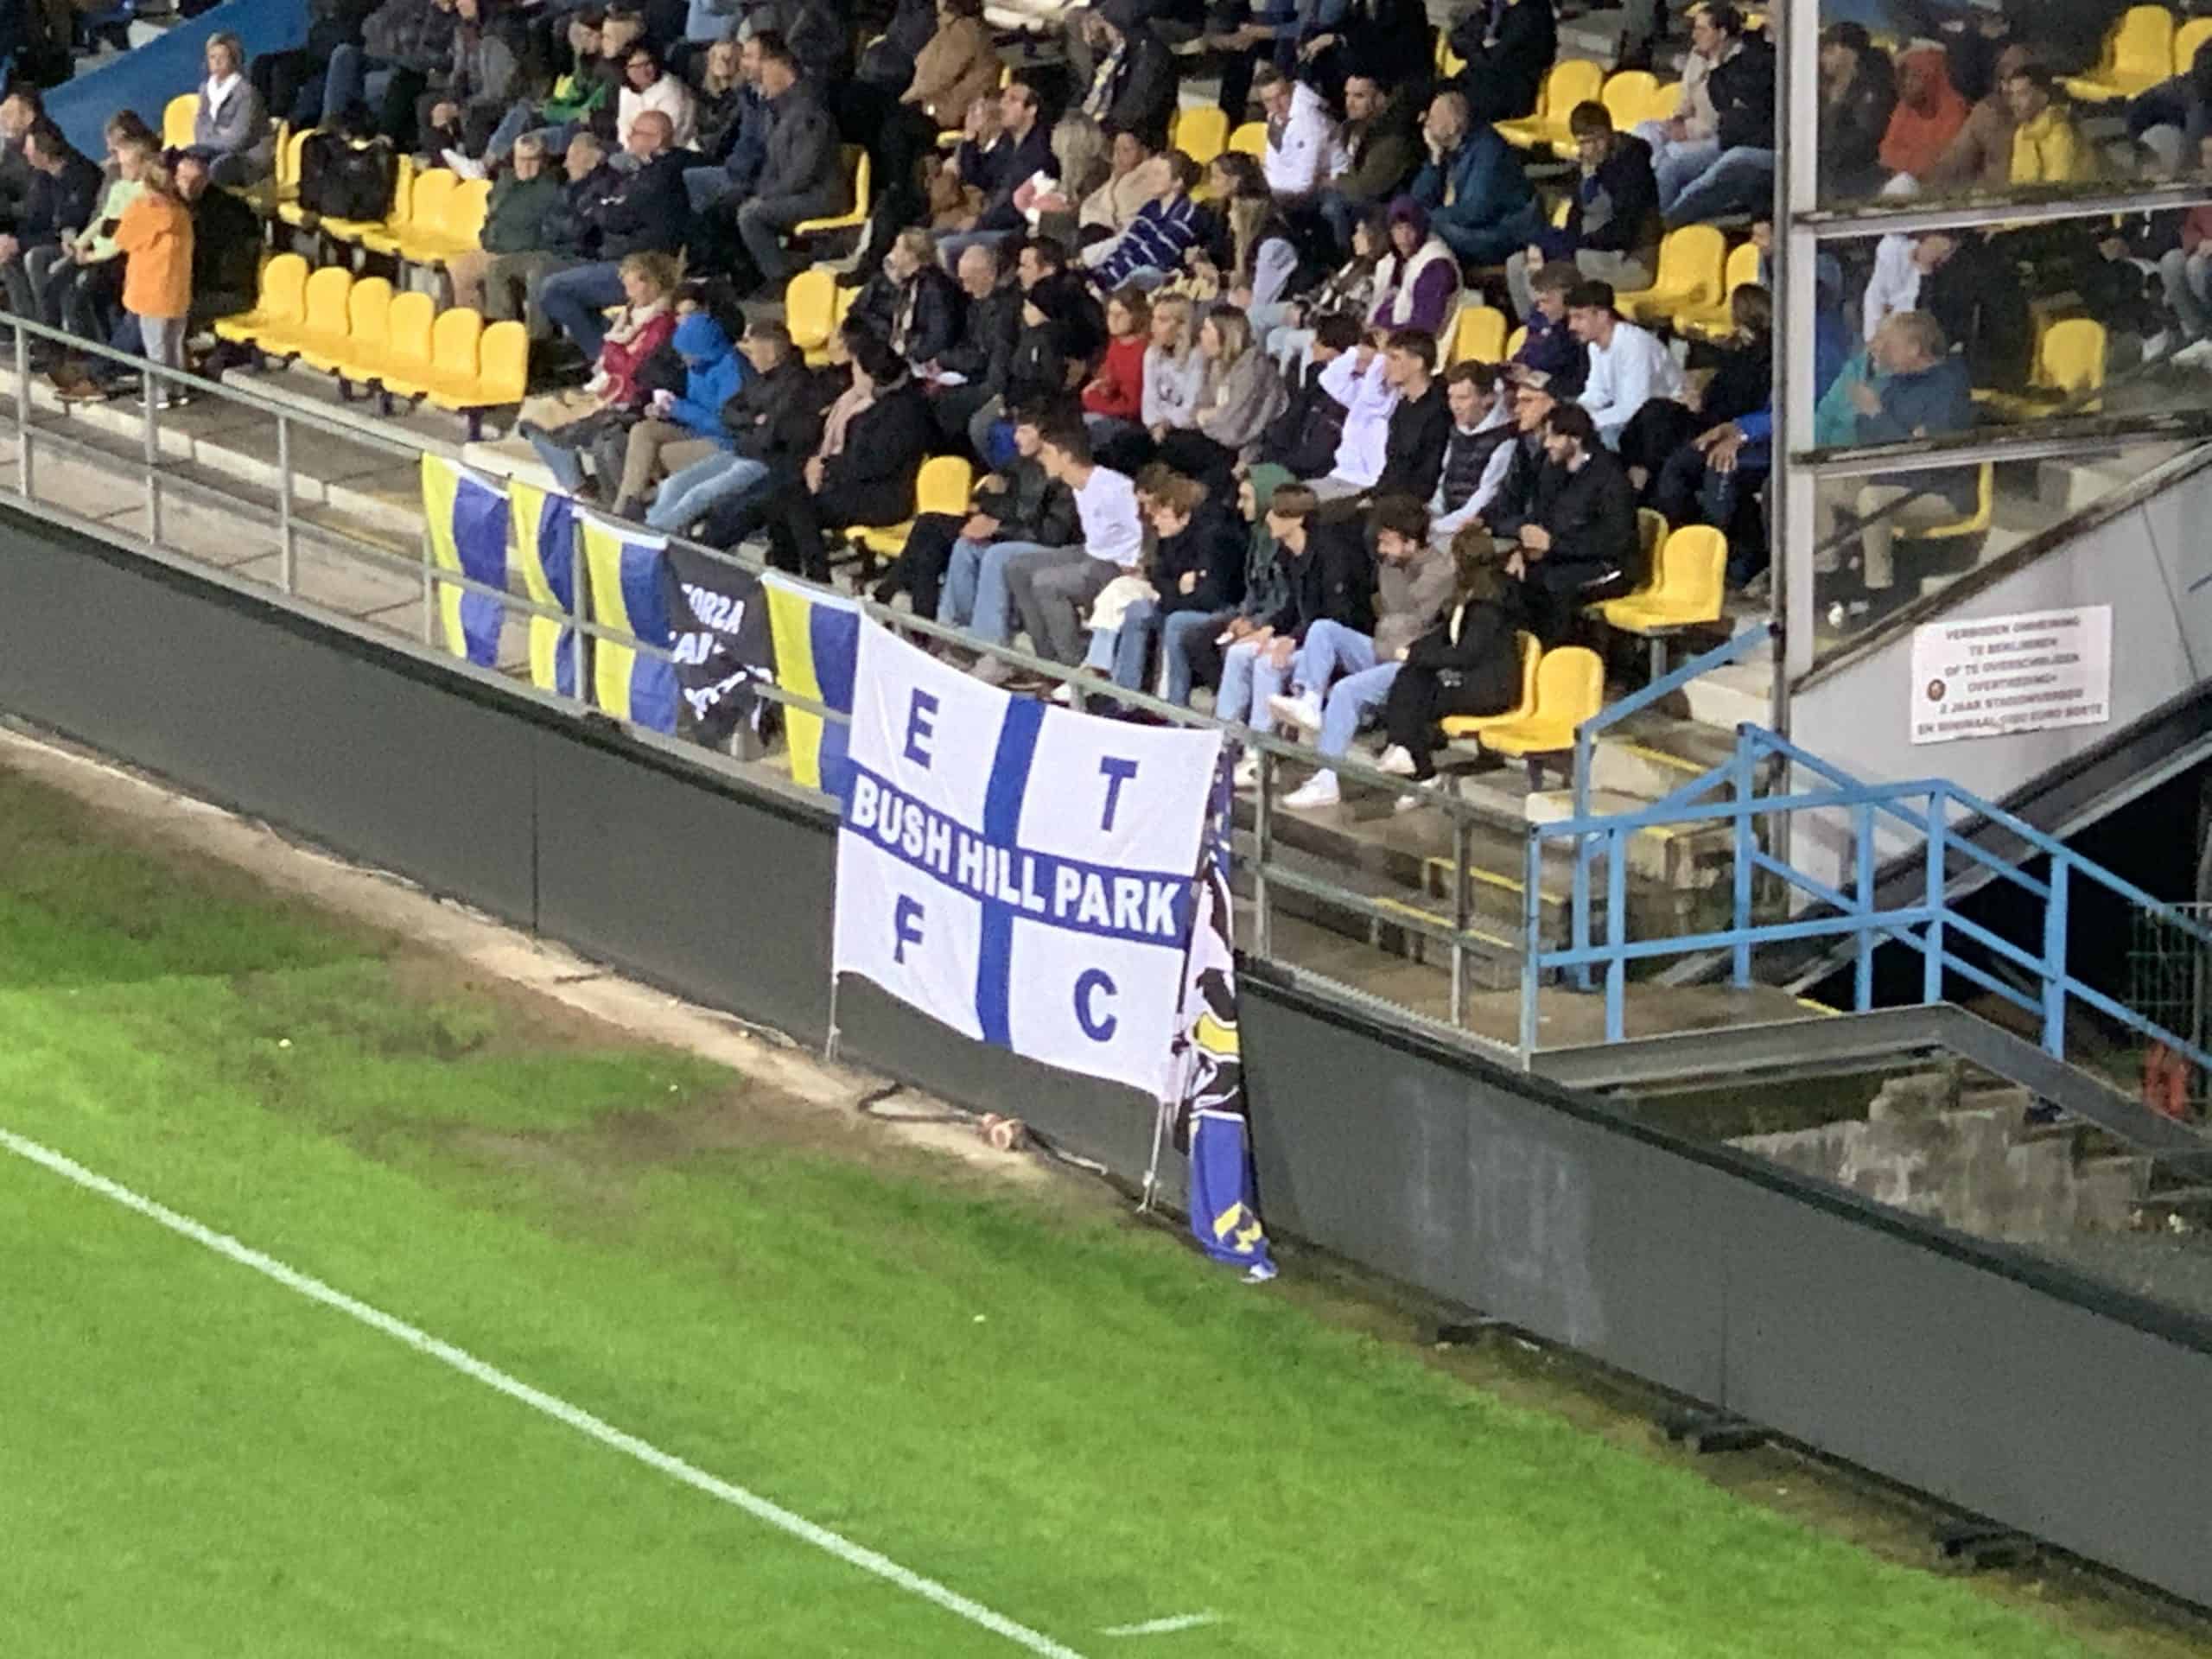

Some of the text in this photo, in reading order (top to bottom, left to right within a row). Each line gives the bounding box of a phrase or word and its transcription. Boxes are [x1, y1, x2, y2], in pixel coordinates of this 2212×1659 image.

[903, 687, 1141, 832] E T
[851, 774, 1183, 938] BUSH HILL PARK
[894, 893, 1119, 1043] F C
